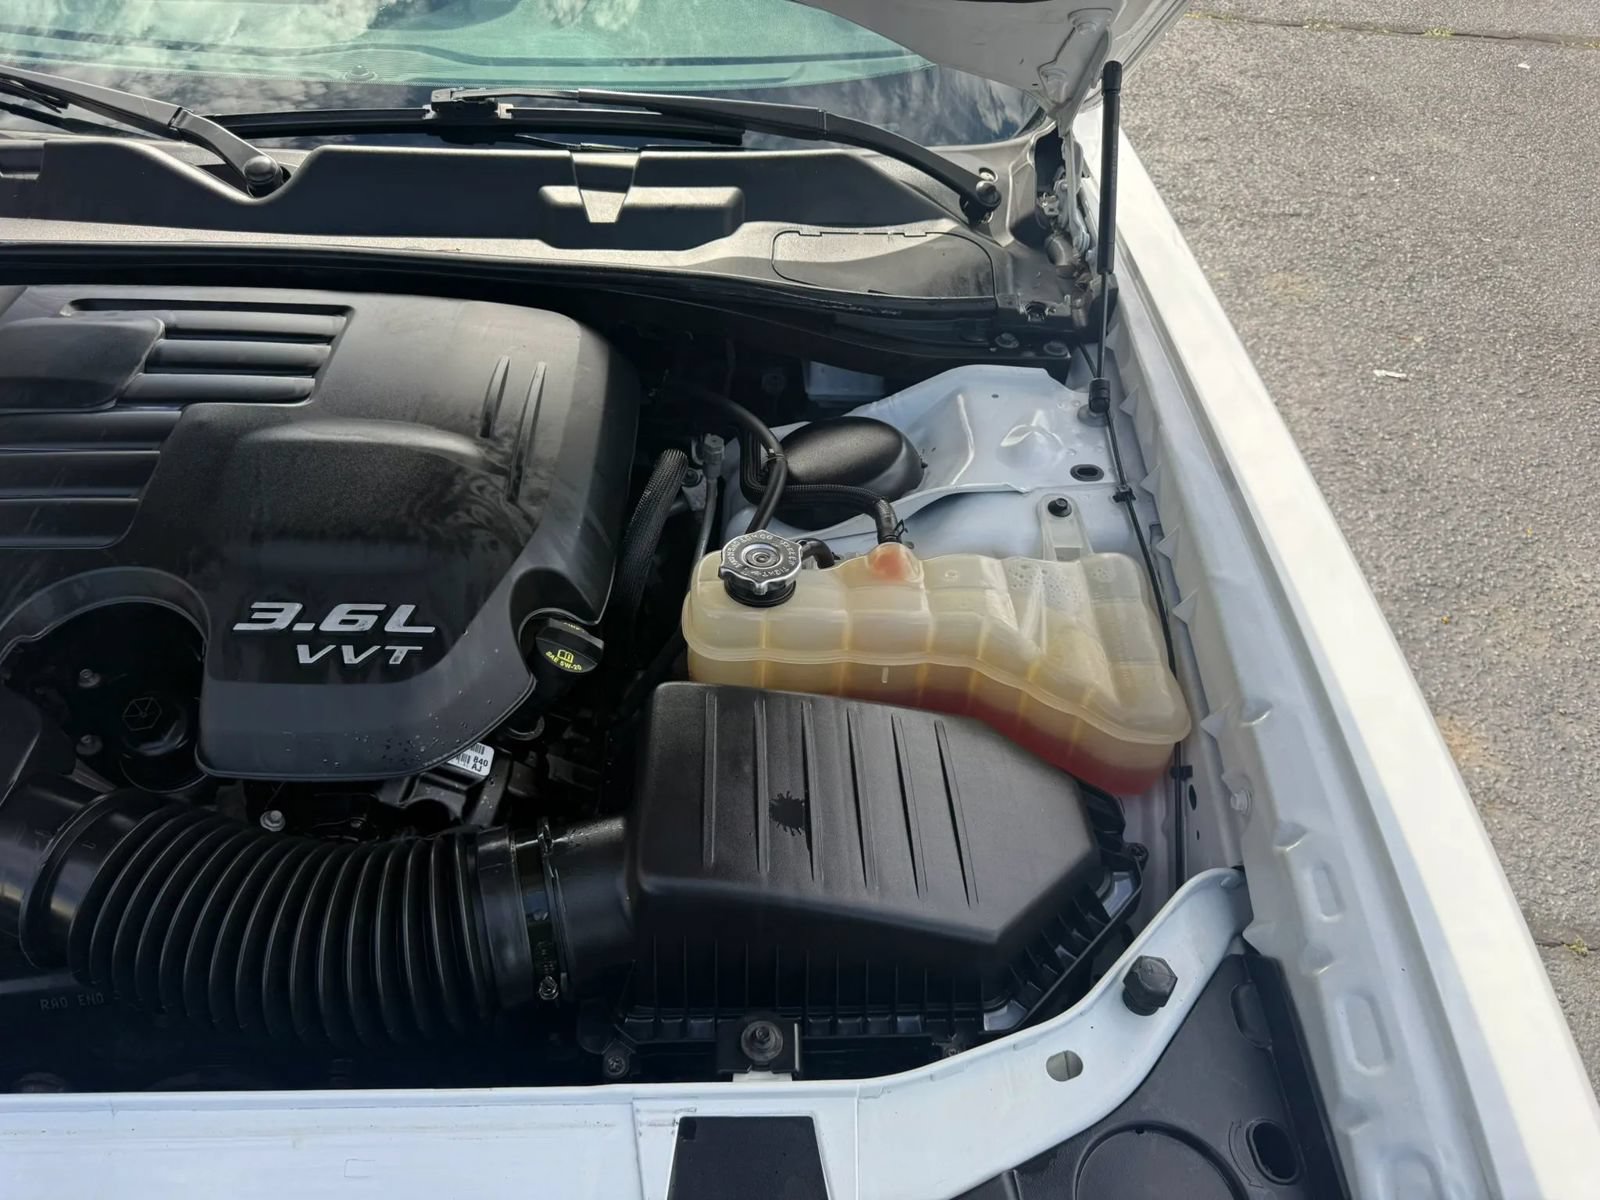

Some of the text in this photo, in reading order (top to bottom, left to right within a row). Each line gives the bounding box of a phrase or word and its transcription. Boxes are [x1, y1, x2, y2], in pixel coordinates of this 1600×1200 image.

[232, 602, 436, 634] 3.6L
[296, 644, 423, 665] VVT
[473, 755, 489, 767] 840
